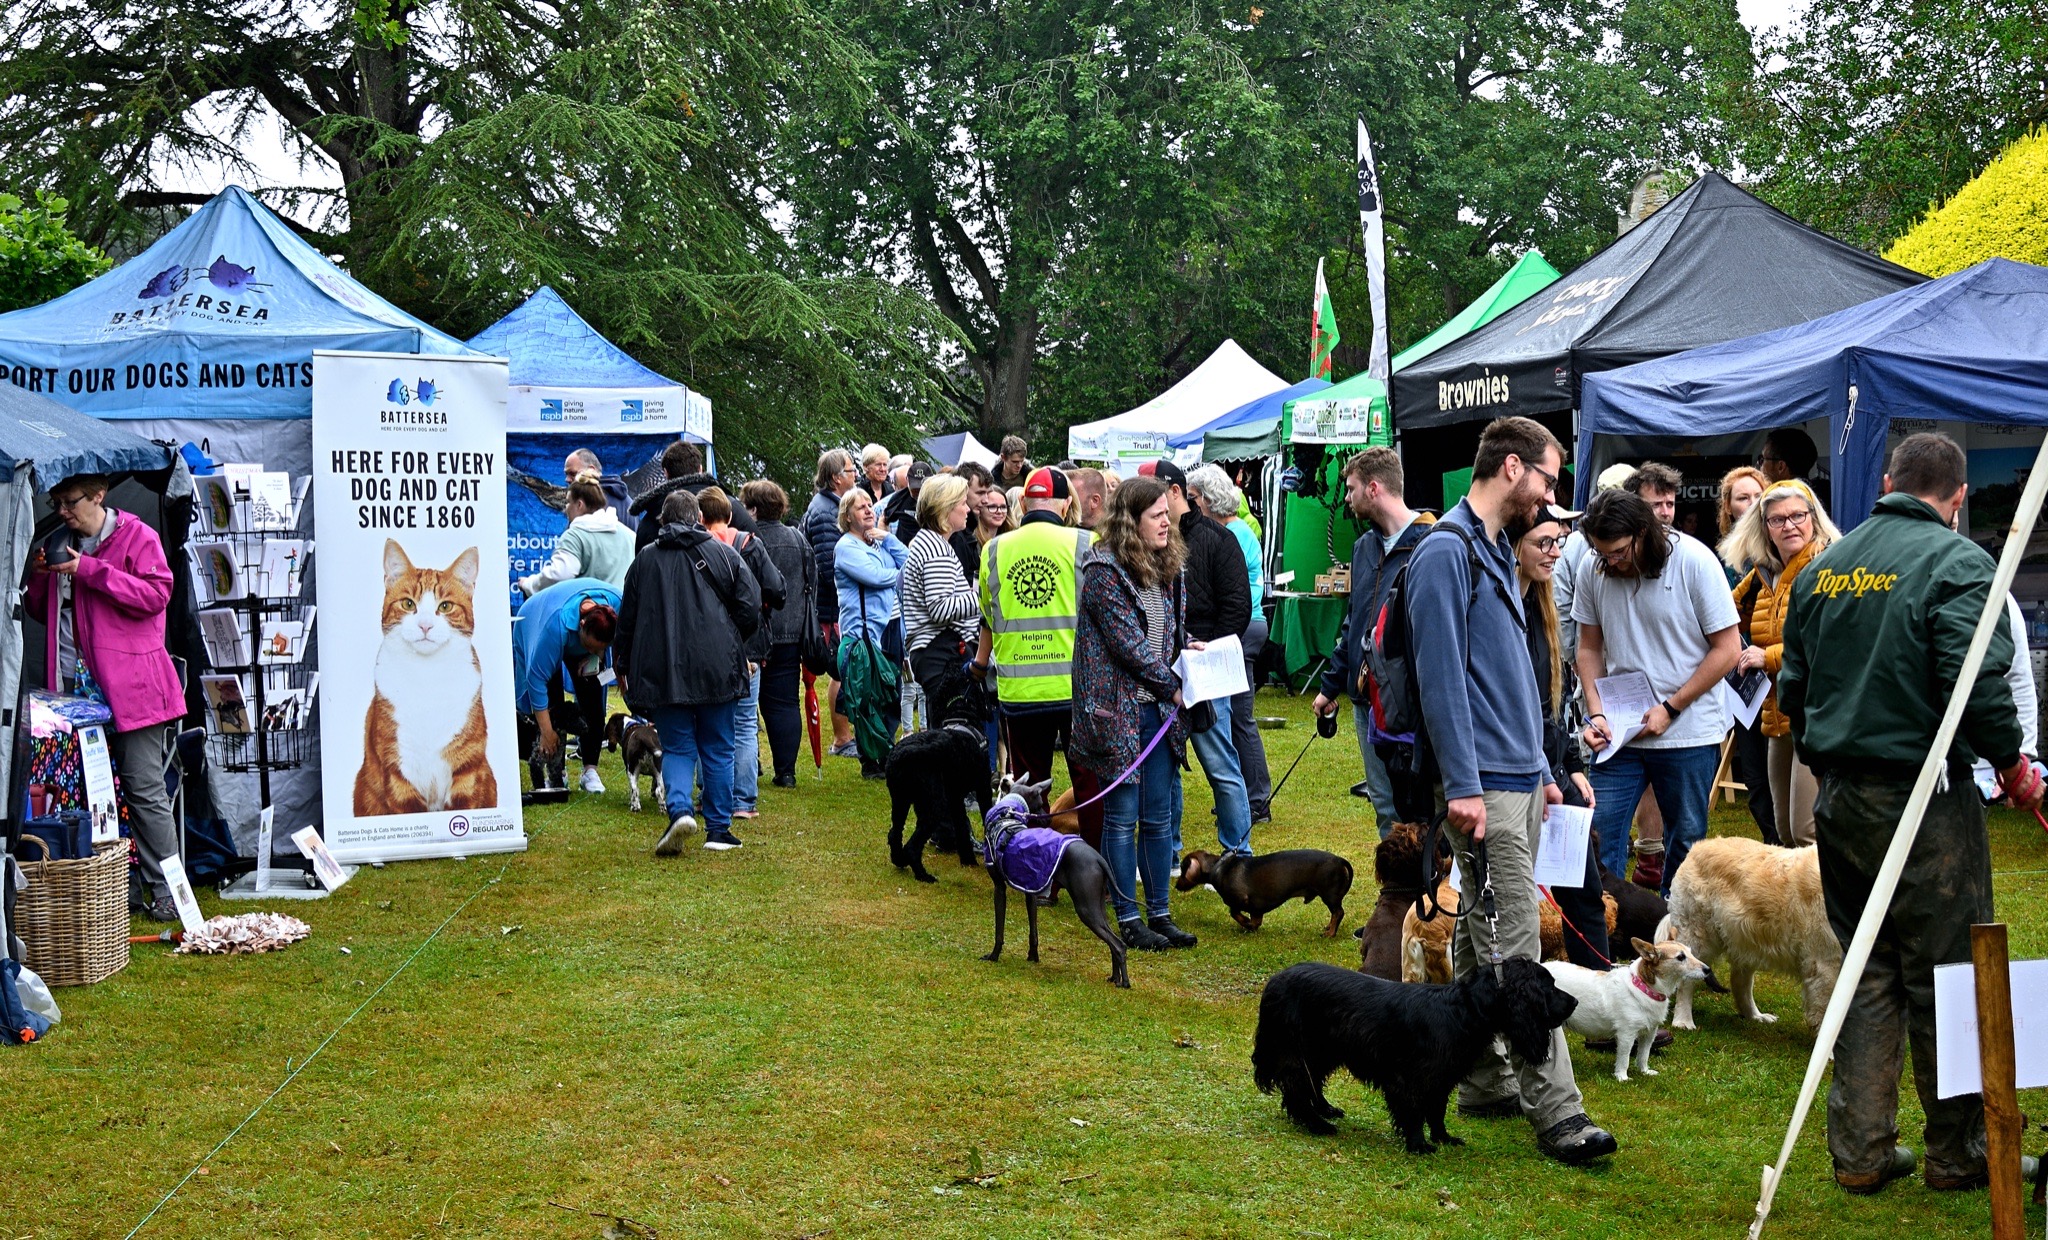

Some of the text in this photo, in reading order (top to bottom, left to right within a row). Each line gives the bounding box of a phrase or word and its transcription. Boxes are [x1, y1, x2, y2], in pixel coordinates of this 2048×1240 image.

[110, 292, 269, 325] BATTERSEA
[190, 311, 214, 321] DOG
[218, 317, 241, 325] AND
[68, 368, 116, 394] OUR
[126, 362, 189, 390] DOGS
[199, 363, 246, 388] AND
[256, 362, 313, 388] CATS
[1438, 367, 1510, 411] Brownies
[380, 410, 448, 425] BATTERSEA
[541, 412, 562, 421] rspb
[621, 412, 643, 422] rspb
[1117, 434, 1151, 442] Greyhound
[1133, 441, 1151, 449] Trust
[331, 450, 494, 475] HERE FOR EVERY
[351, 478, 480, 501] DOG AND CAT
[1675, 485, 1721, 499] PICTU
[358, 505, 475, 528] SINCE 1860
[507, 533, 560, 549] about
[1006, 558, 1026, 580] MERCIA
[1032, 555, 1062, 576] MARCHES
[1812, 567, 1897, 598] TopSpec
[1022, 633, 1053, 641] Helping
[1013, 652, 1066, 661] Communities
[452, 821, 466, 831] FR
[472, 818, 515, 826] FUNDRAISING
[472, 824, 515, 833] REGULATOR
[337, 836, 361, 844] registered
[367, 834, 387, 842] England
